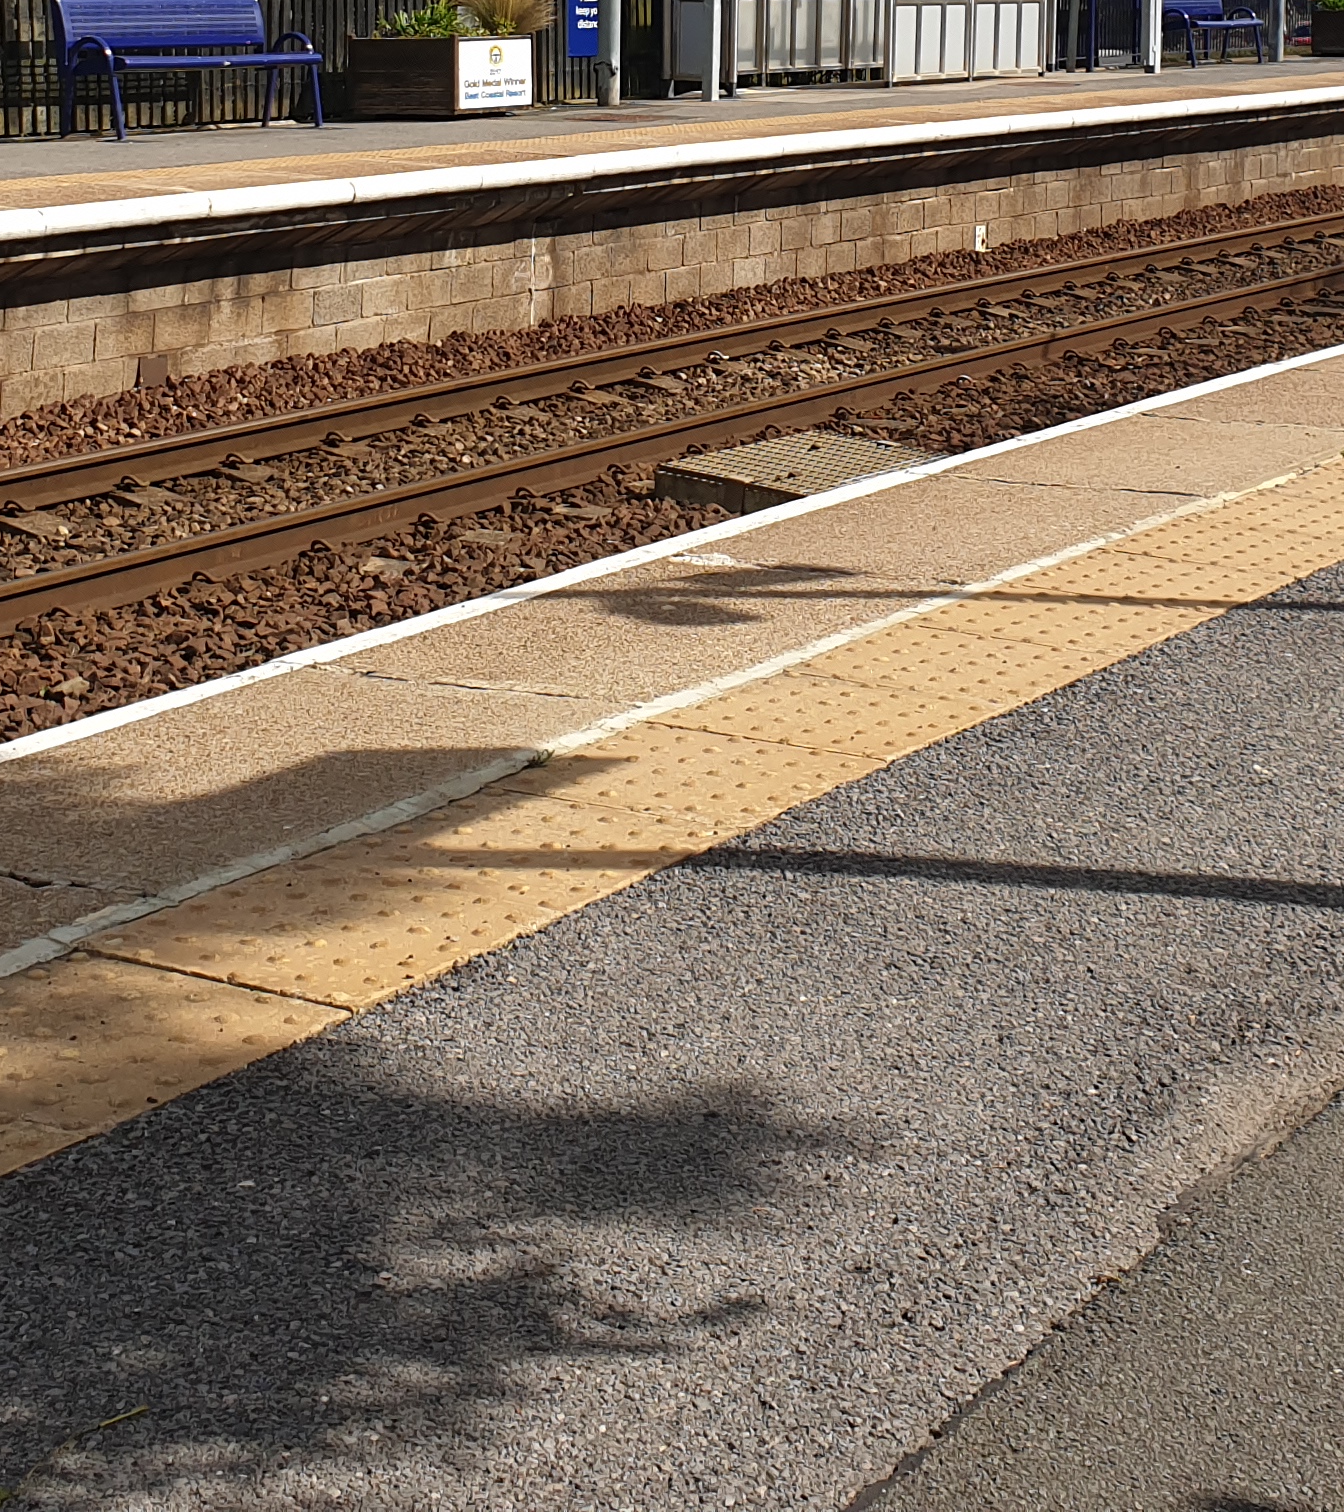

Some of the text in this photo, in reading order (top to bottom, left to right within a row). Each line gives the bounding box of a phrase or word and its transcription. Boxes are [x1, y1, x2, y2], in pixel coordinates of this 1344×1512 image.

[575, 5, 590, 17] keep
[464, 77, 526, 88] Gold Medal Winner
[465, 89, 526, 100] Best Coastal Resort
